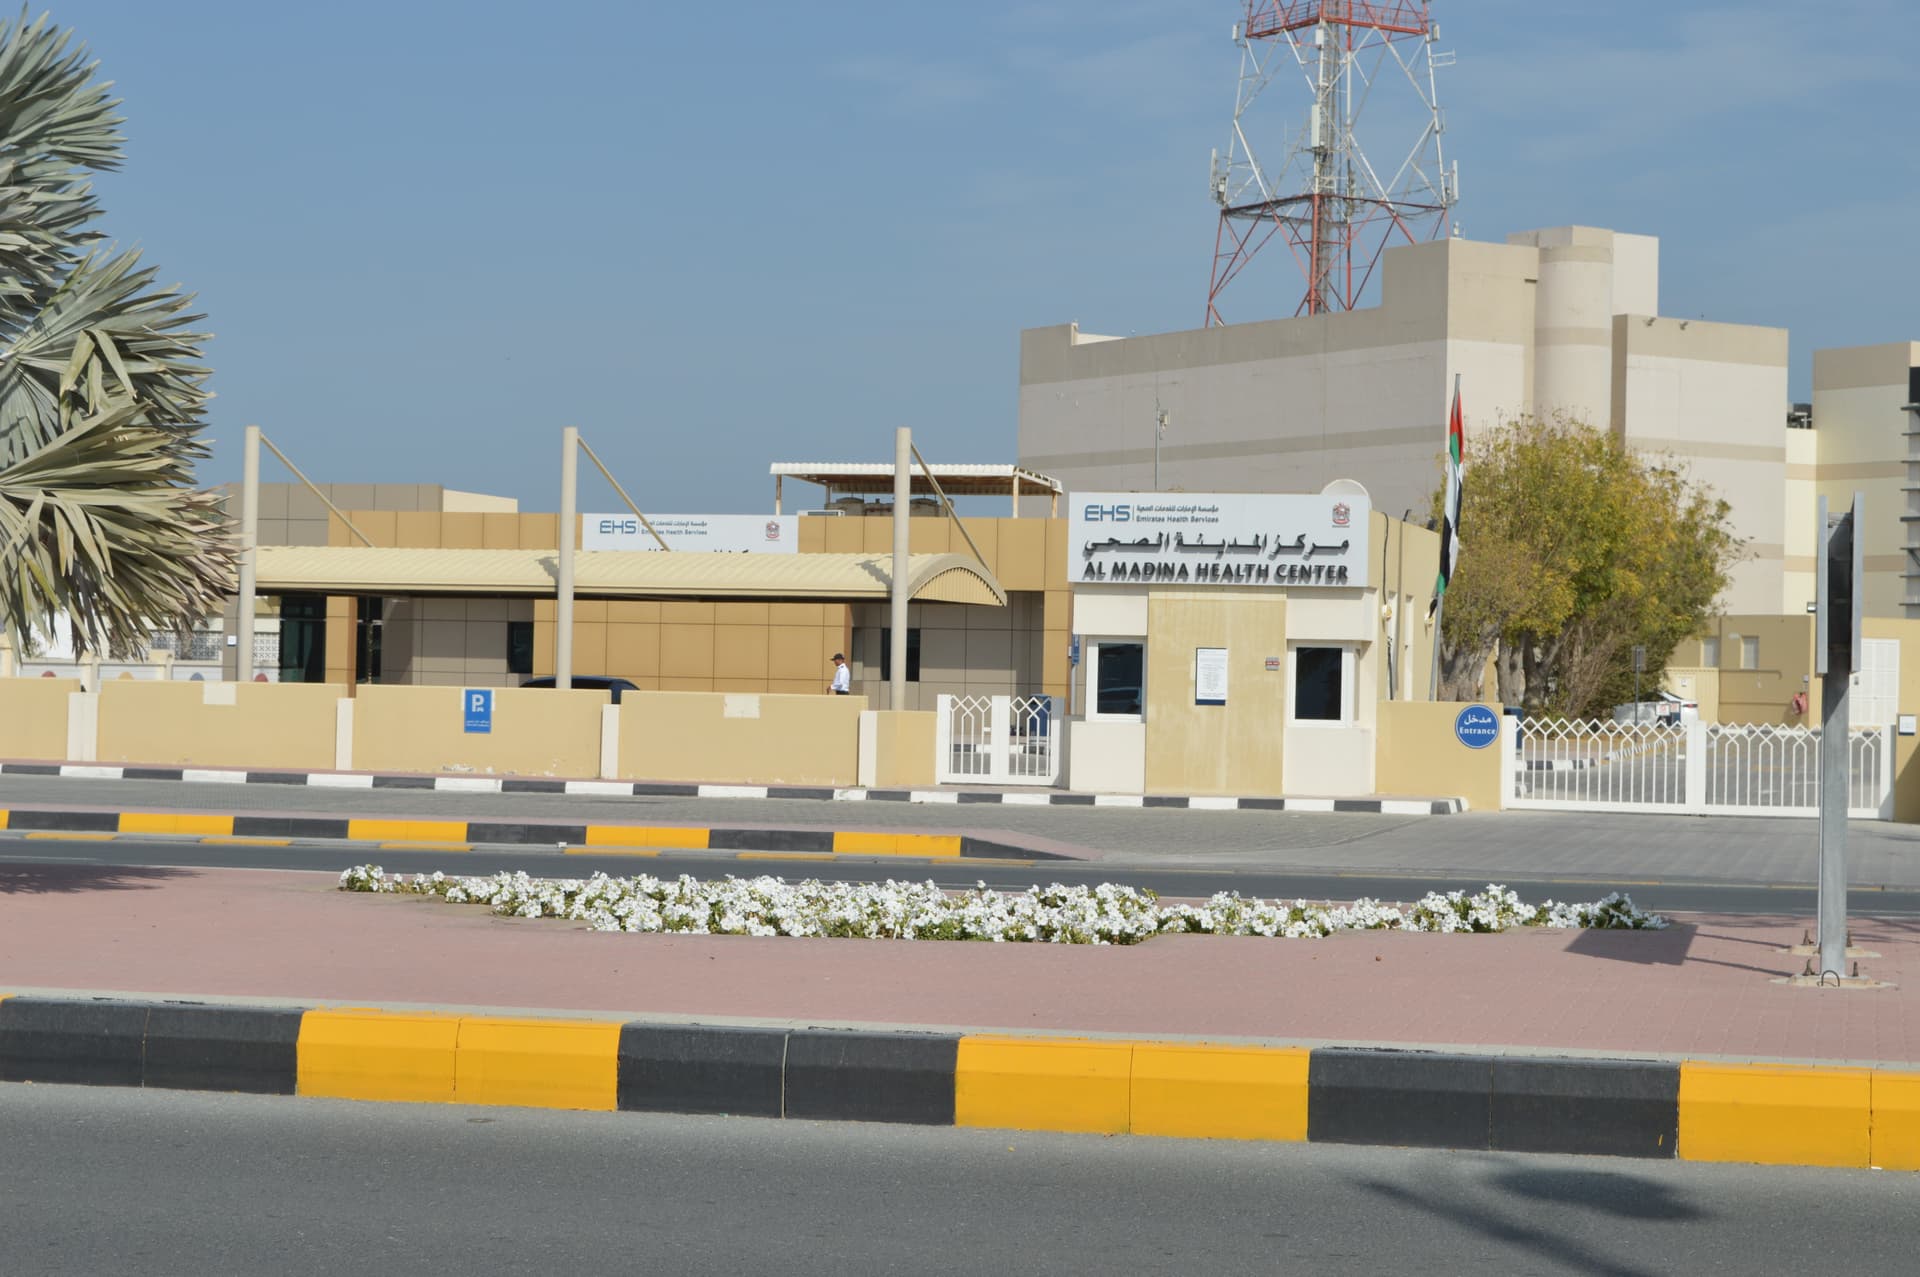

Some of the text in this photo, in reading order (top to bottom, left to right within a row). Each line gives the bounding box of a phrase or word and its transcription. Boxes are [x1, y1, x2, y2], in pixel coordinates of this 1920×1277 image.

[1084, 505, 1131, 522] EHS
[1136, 515, 1219, 523] Emirates Health Services
[600, 520, 636, 535] EHS
[1175, 531, 1268, 556] المدينة
[1271, 533, 1350, 557] مركز
[1084, 561, 1349, 582] AL MADINA HEALTH CENTER
[472, 694, 484, 712] P
[1464, 713, 1492, 725] مدخل
[1459, 727, 1495, 735] Entrance
